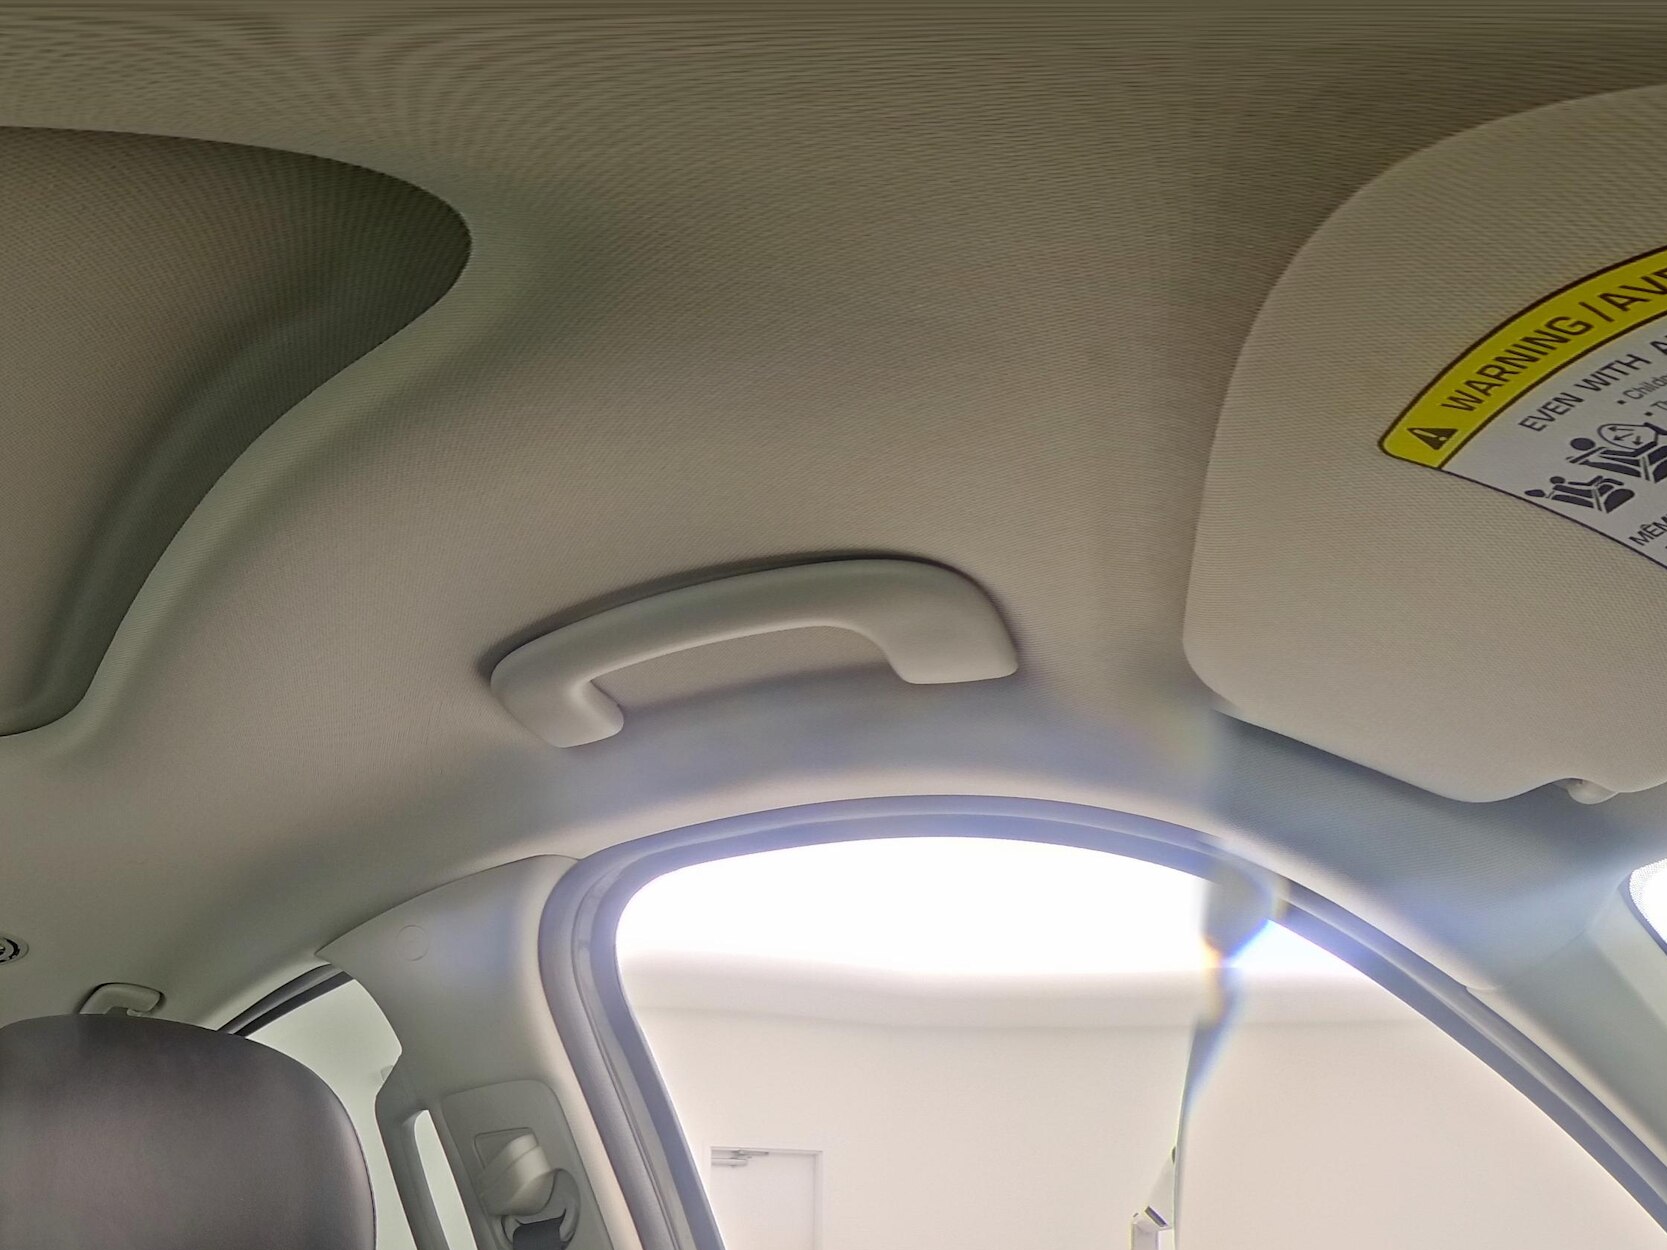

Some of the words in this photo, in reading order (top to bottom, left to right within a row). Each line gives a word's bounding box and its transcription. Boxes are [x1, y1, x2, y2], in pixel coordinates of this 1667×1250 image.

[1441, 317, 1593, 411] WARNING
[1518, 392, 1584, 431] EVEN
[1574, 354, 1652, 391] WITH
